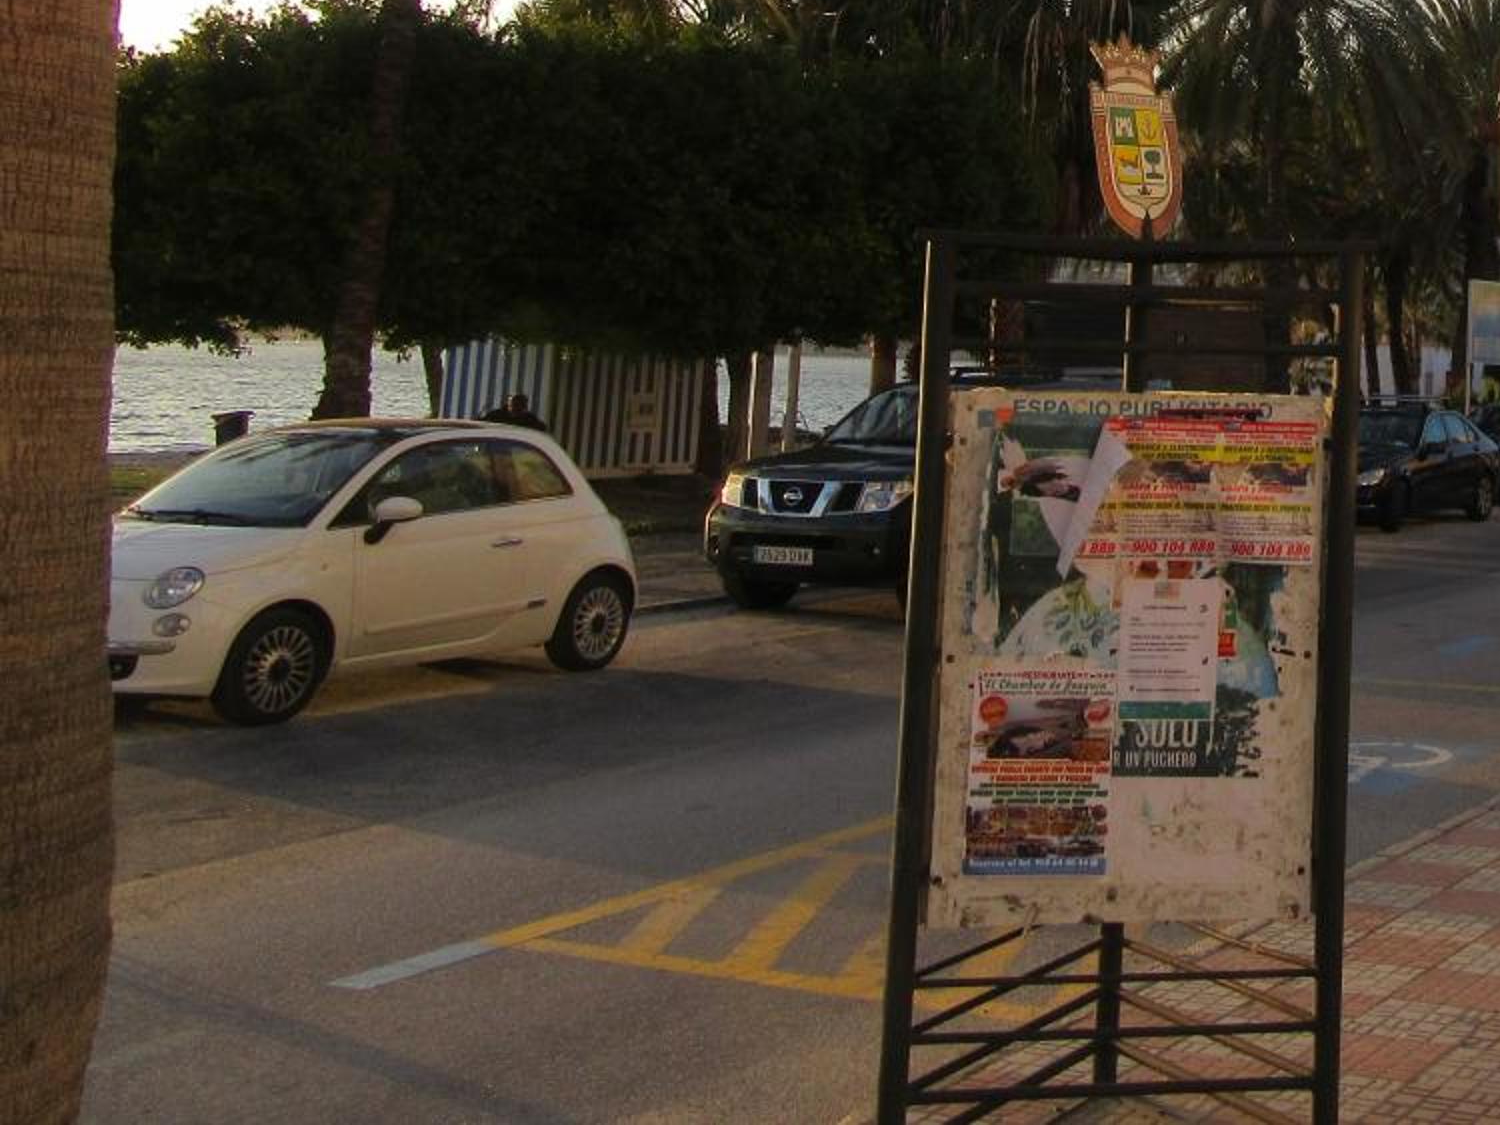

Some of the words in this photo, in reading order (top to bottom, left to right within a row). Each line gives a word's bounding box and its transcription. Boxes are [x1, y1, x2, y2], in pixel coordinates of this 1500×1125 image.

[1013, 398, 1112, 418] ESPACIO
[1132, 539, 1158, 554] 900
[1163, 539, 1185, 554] 104
[1230, 542, 1255, 556] 900
[1259, 542, 1283, 556] 104
[1143, 750, 1197, 768] PUCHERO
